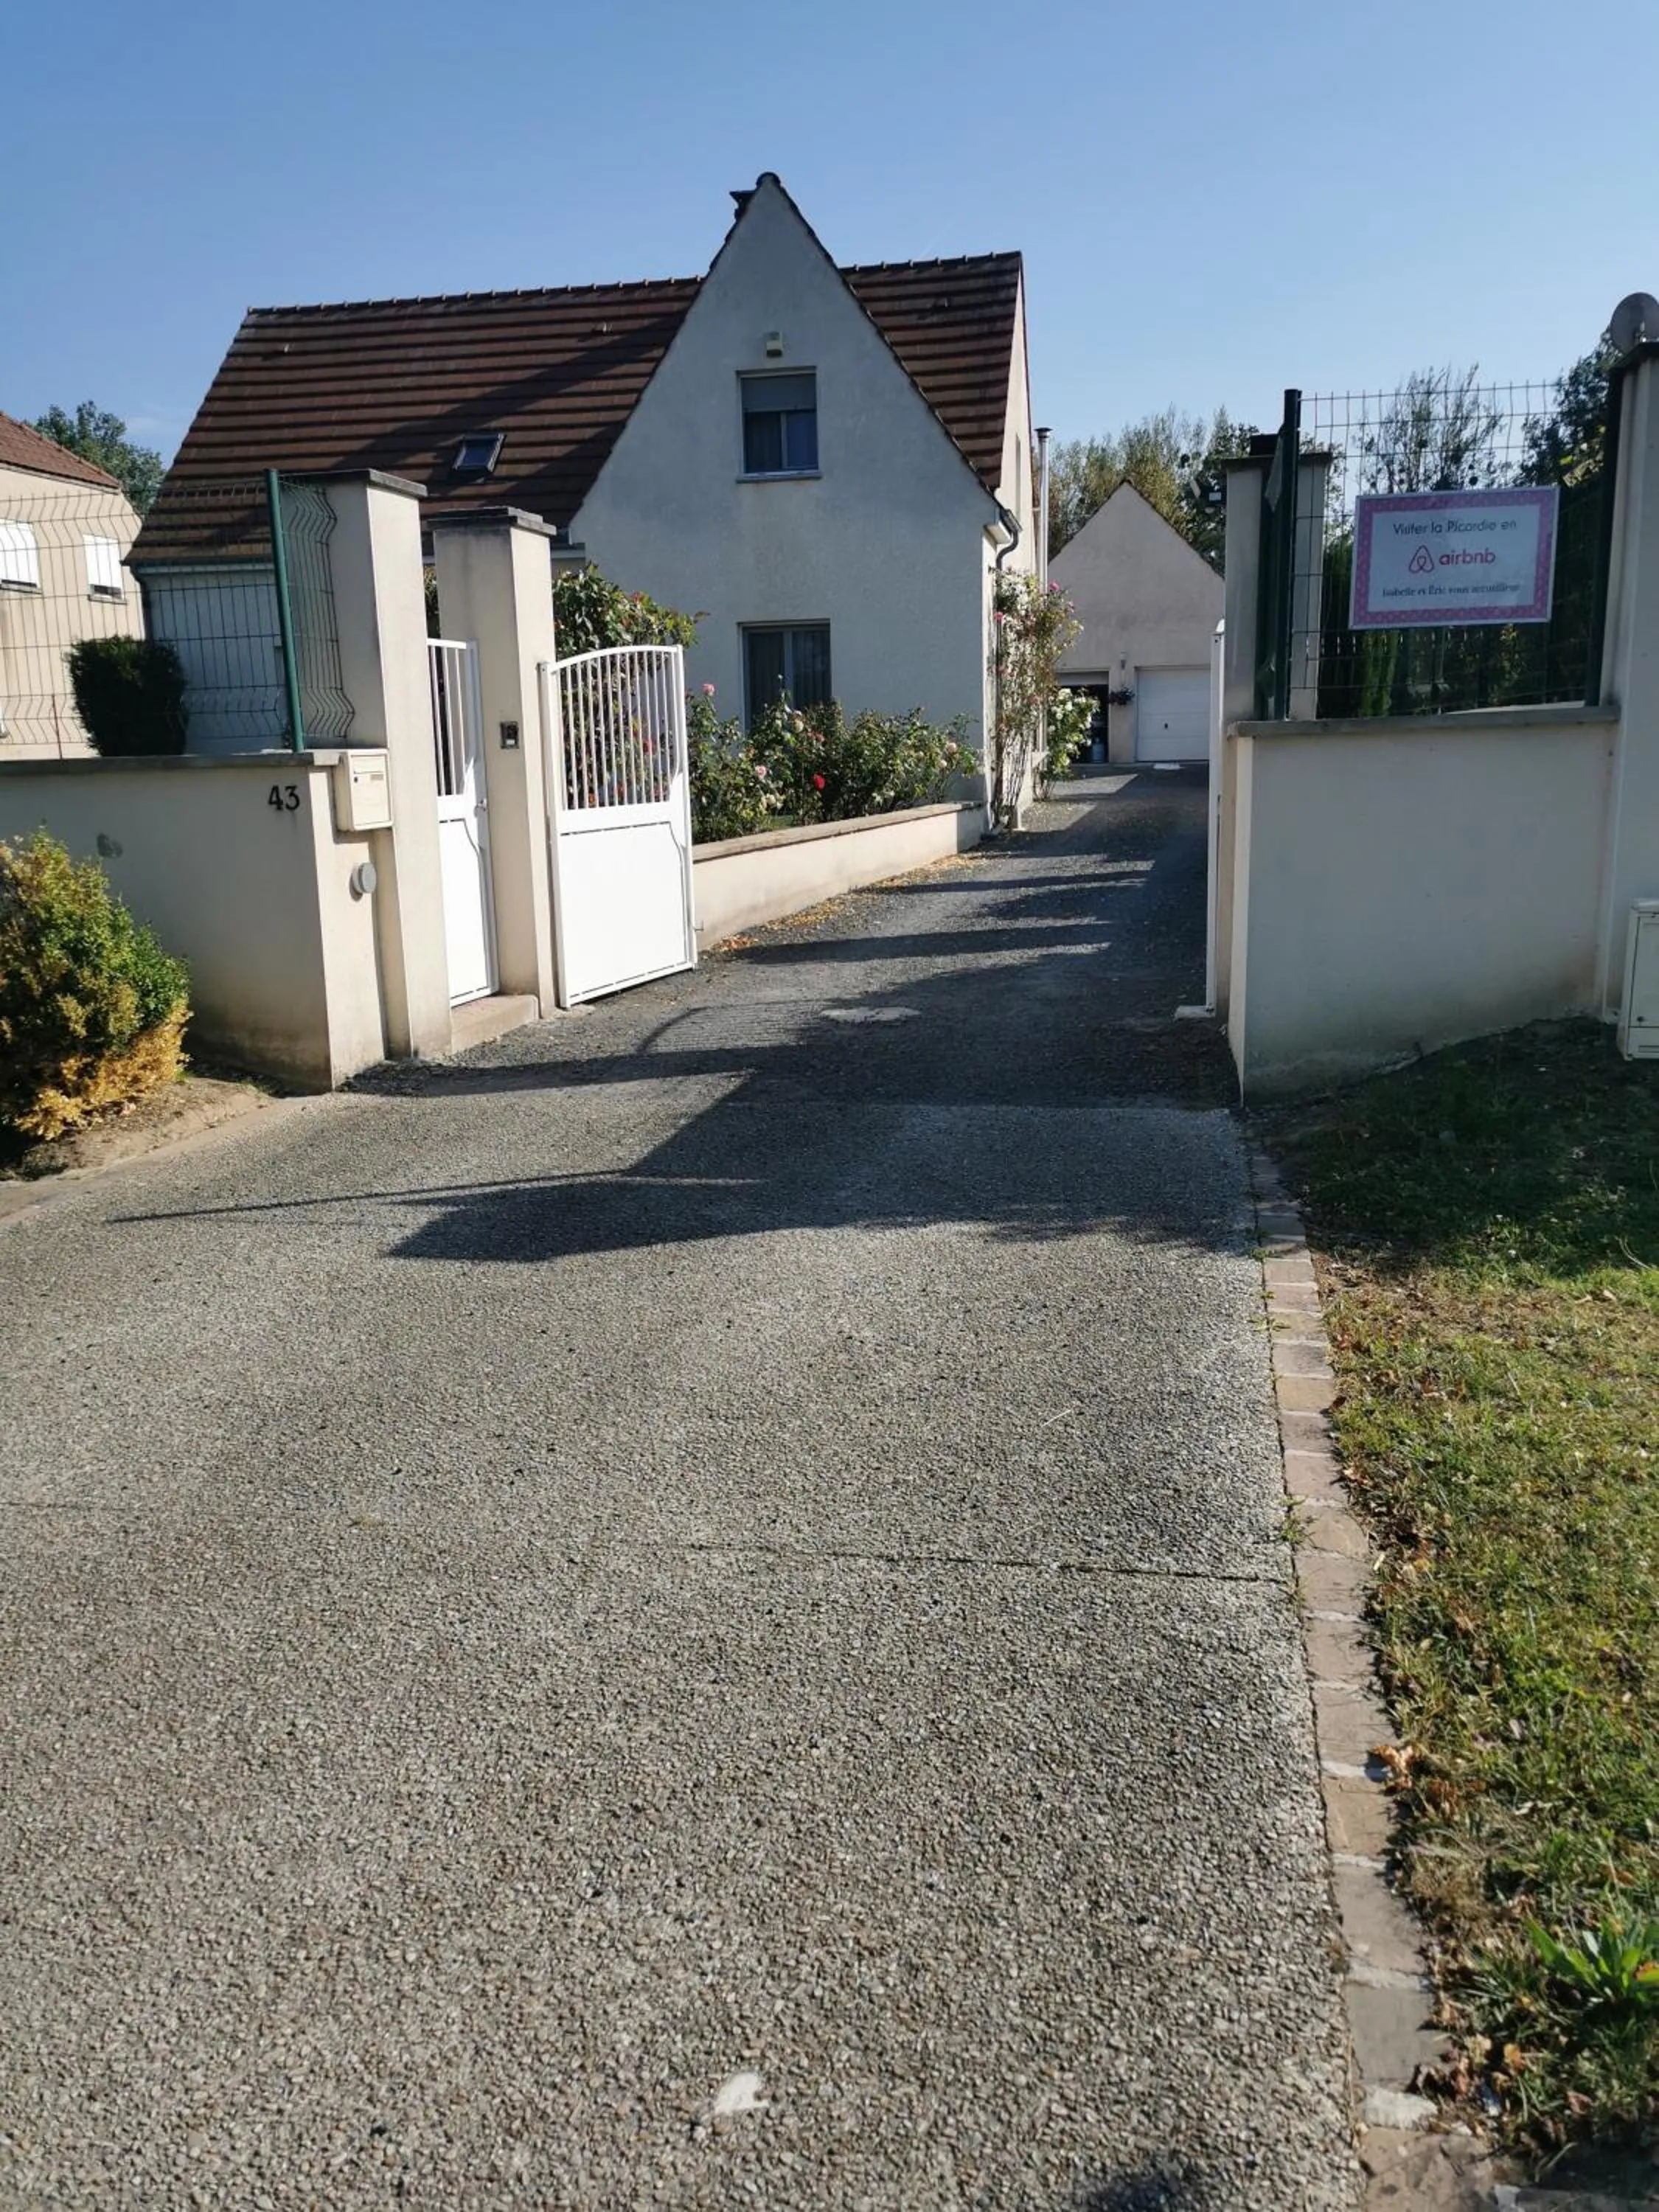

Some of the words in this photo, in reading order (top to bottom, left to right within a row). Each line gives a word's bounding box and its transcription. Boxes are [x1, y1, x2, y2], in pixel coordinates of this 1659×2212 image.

[1430, 521, 1443, 533] la
[1447, 518, 1497, 532] Picardie
[1500, 520, 1517, 530] en
[1439, 547, 1496, 566] airbnb
[268, 785, 301, 810] 43
